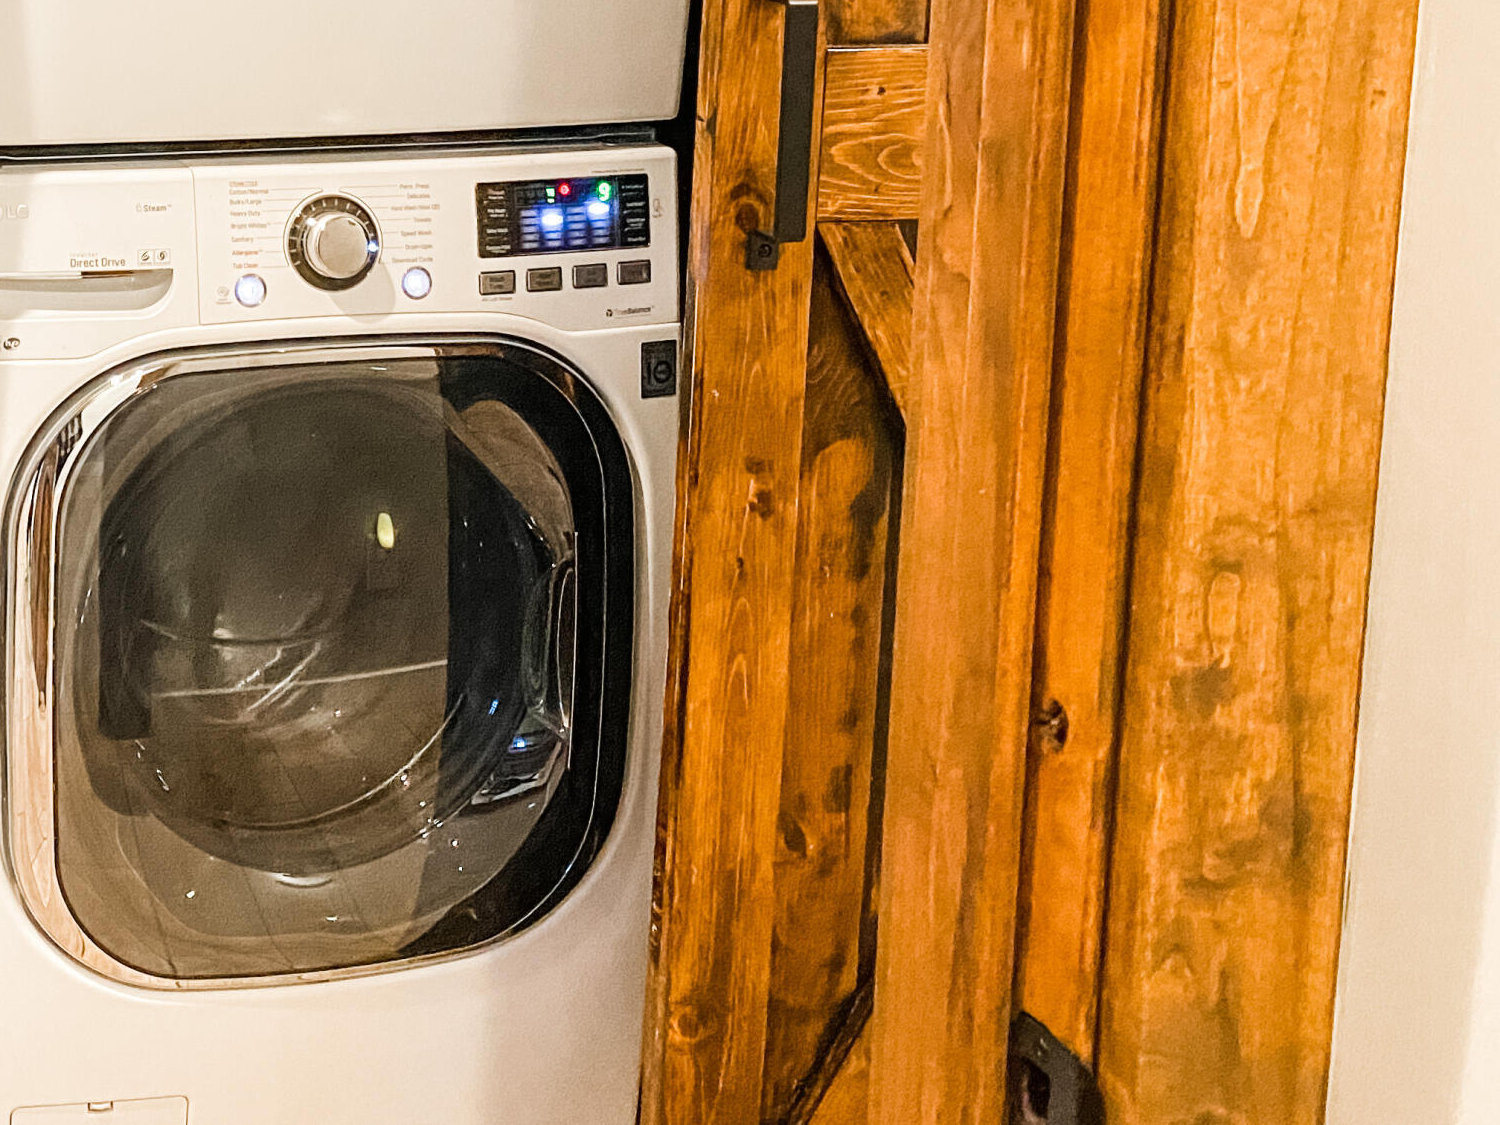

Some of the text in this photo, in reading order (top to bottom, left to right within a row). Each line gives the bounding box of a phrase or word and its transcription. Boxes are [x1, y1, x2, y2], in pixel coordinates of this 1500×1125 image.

[598, 182, 611, 201] 9
[70, 257, 126, 268] Direct Drive
